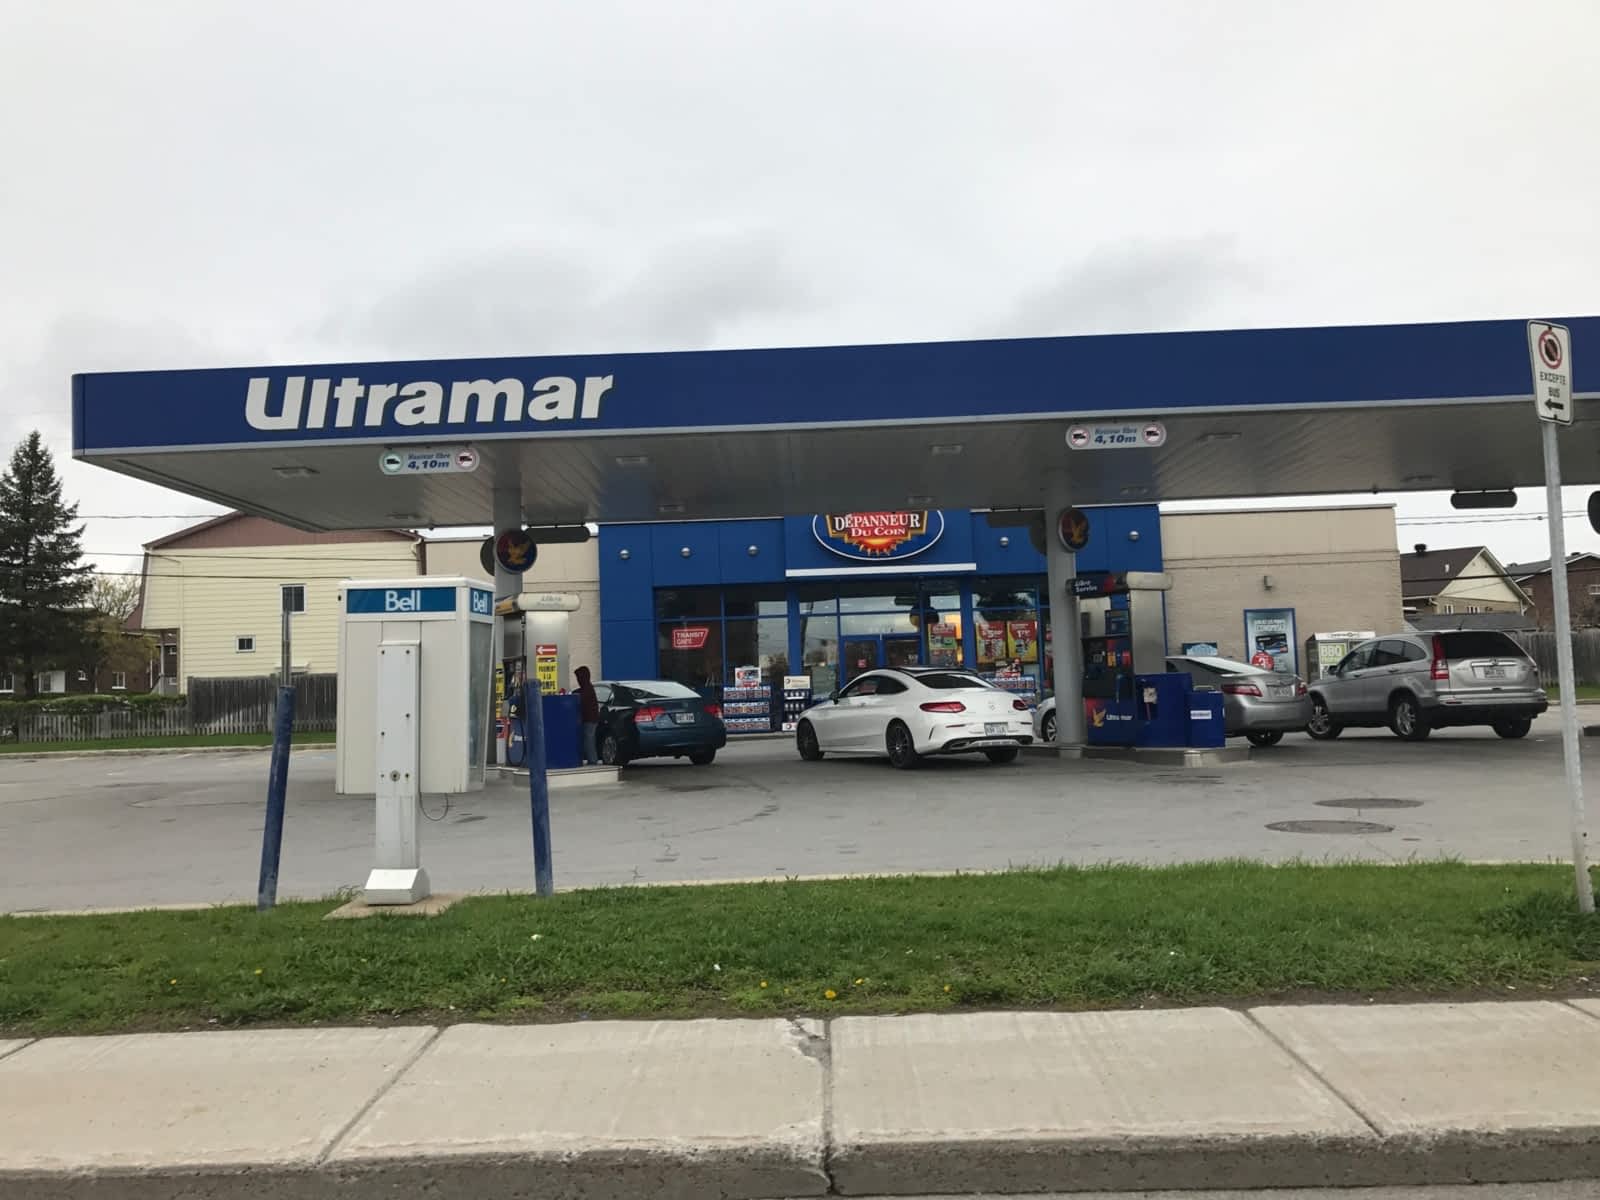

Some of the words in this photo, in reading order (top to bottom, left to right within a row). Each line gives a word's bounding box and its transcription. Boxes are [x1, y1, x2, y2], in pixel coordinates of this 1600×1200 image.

[245, 374, 614, 431] Ultramar
[407, 460, 450, 470] 4,10m
[834, 513, 921, 531] DÉPANNEUR
[384, 589, 421, 612] Bell
[472, 590, 489, 613] Bell
